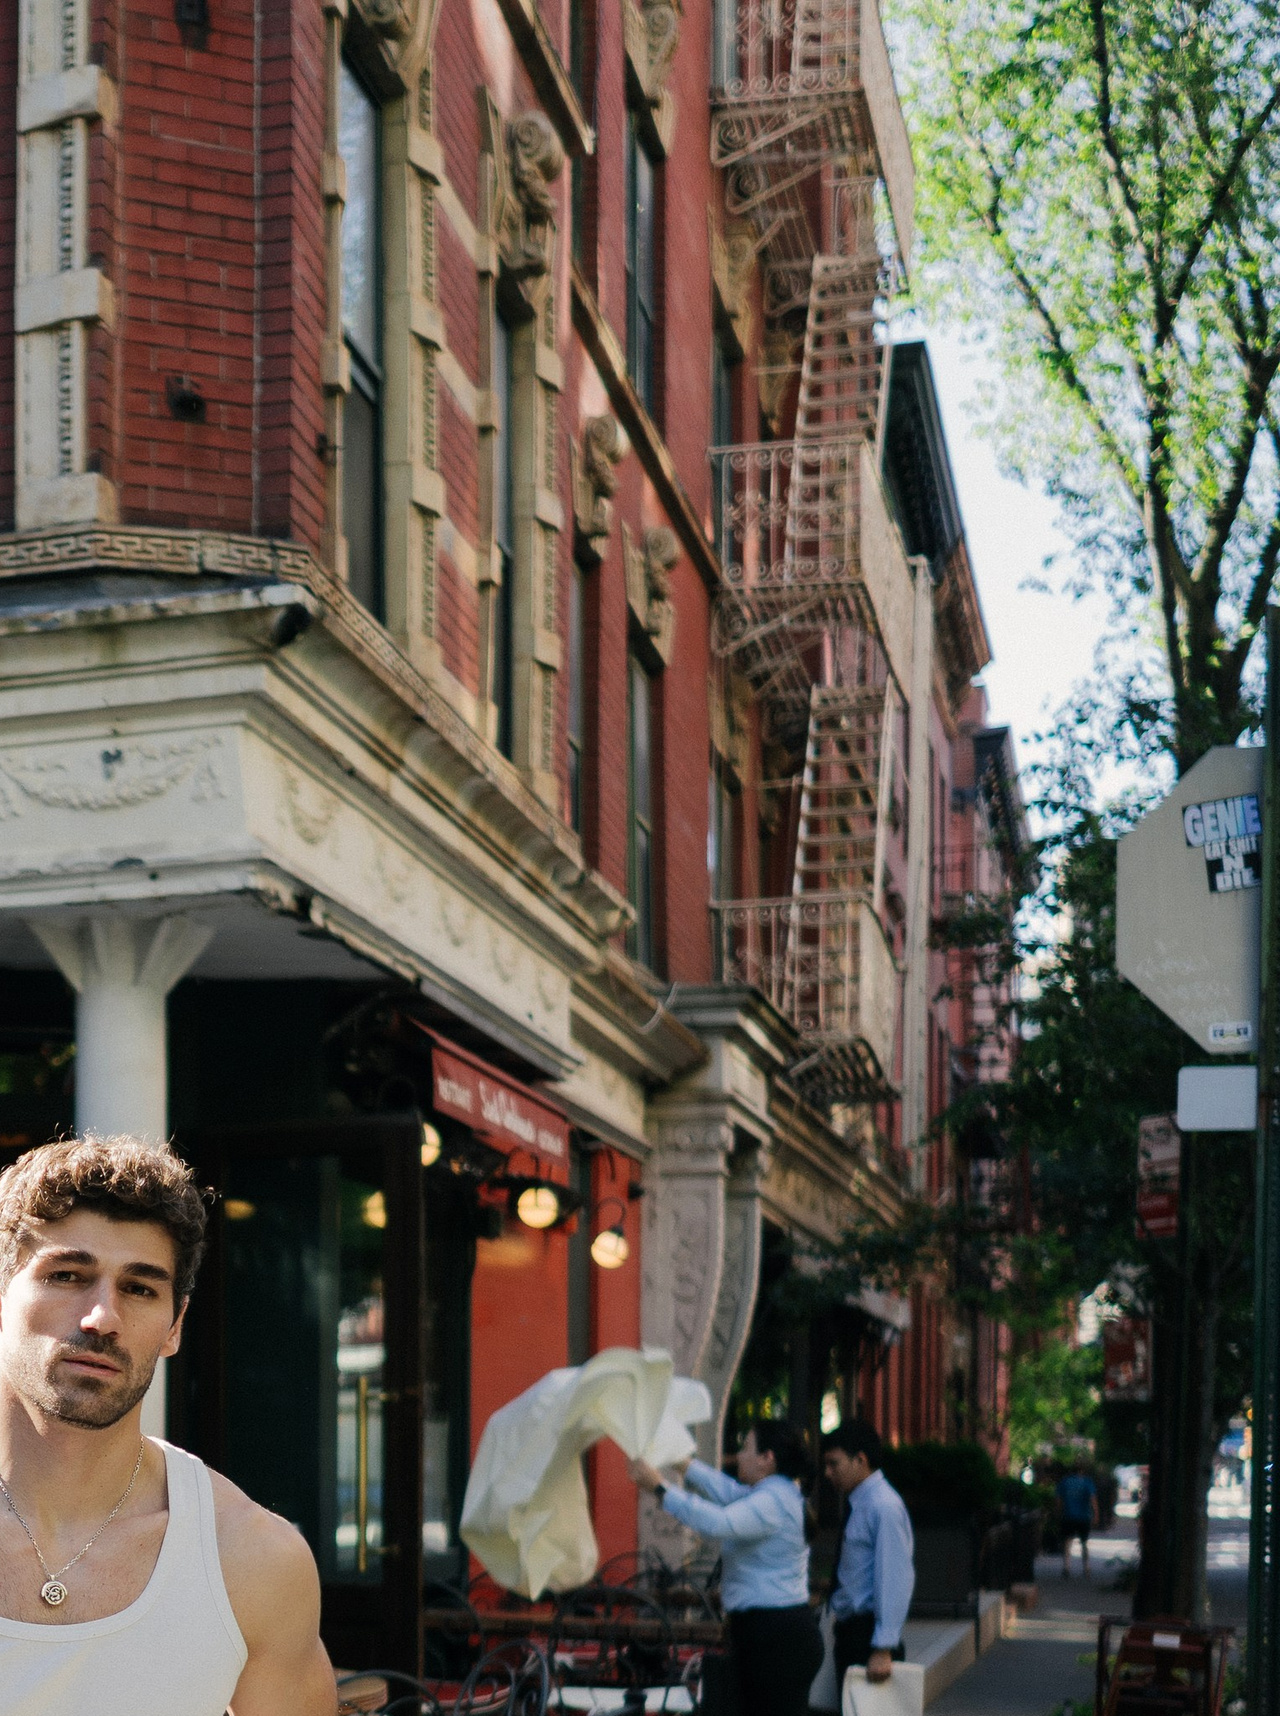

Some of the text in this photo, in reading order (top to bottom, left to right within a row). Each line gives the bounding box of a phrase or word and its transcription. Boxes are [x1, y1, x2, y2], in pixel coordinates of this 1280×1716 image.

[1184, 797, 1261, 847] GENIE
[1222, 852, 1245, 874] N
[1216, 867, 1261, 892] DIE
